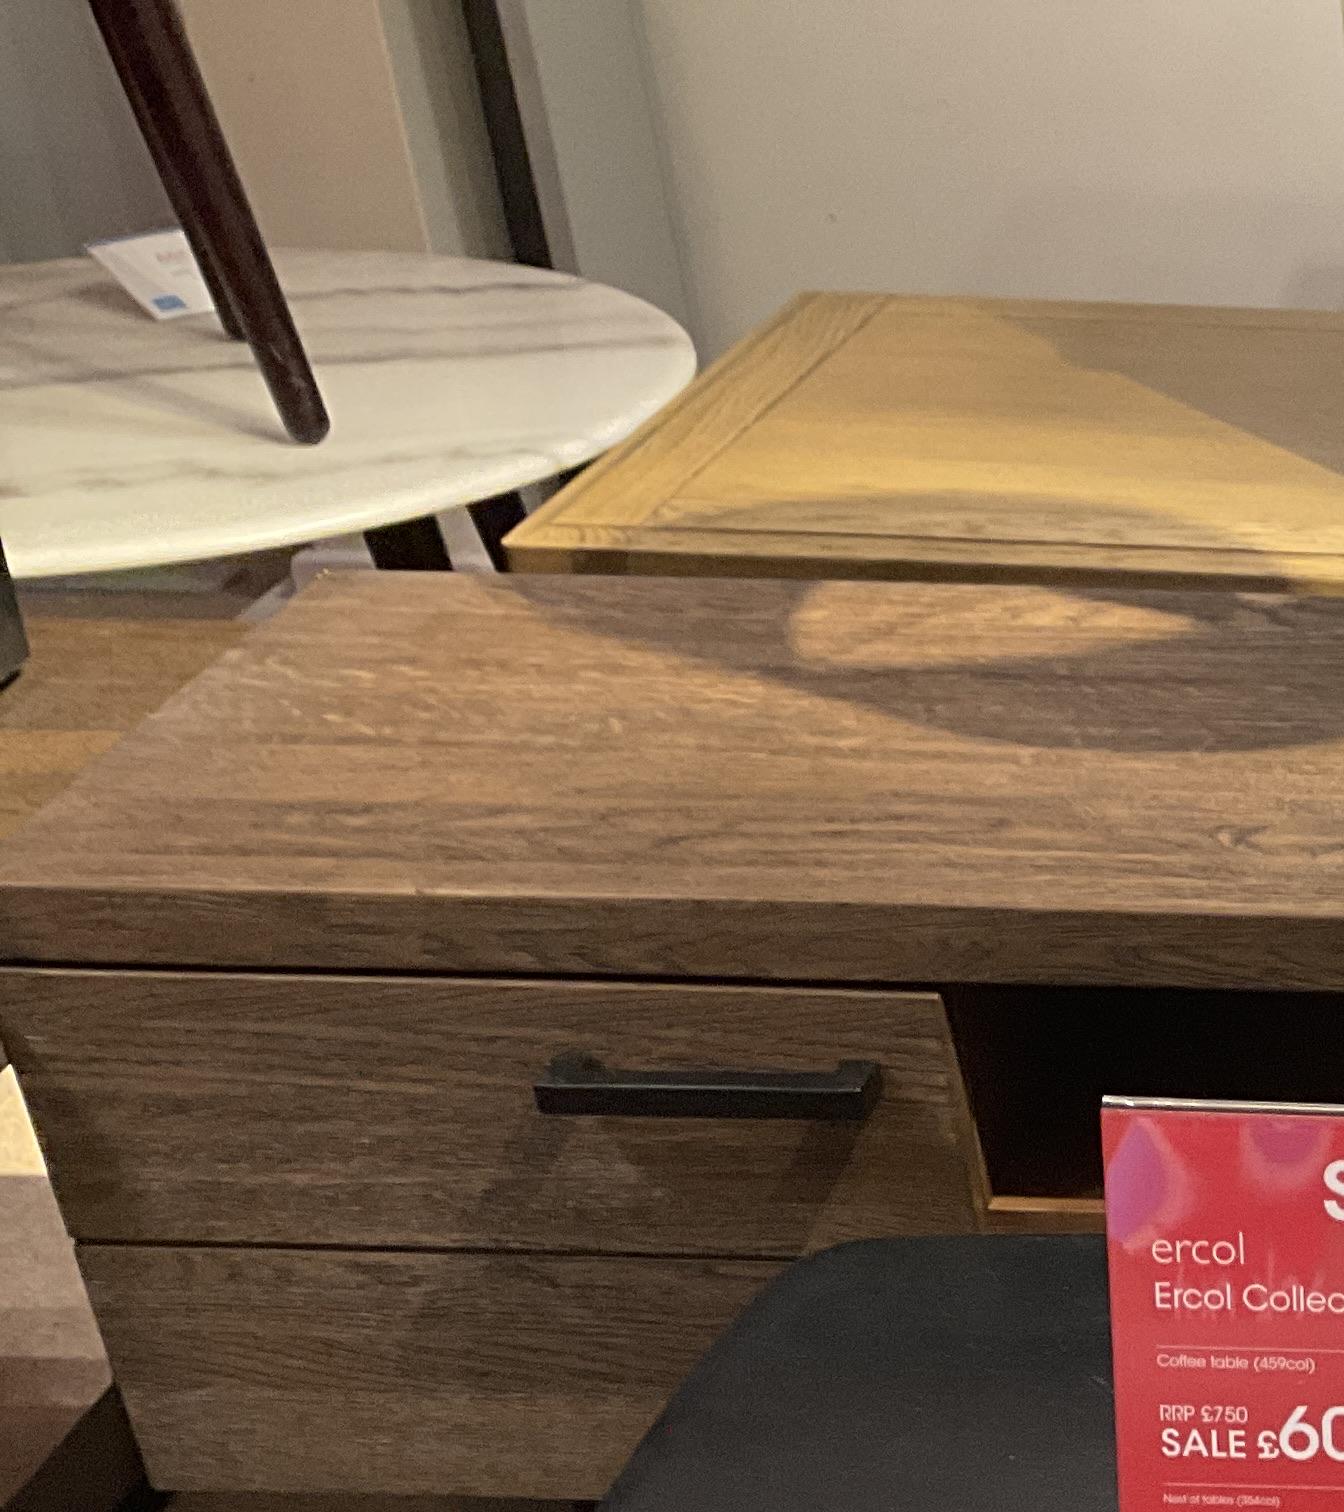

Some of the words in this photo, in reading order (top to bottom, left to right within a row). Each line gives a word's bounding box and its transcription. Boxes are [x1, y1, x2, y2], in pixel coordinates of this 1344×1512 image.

[1151, 1232, 1245, 1265] ercol
[1154, 1281, 1232, 1312] Ercol
[1157, 1354, 1206, 1368] Coffee
[1211, 1355, 1248, 1369] table
[1254, 1357, 1315, 1374] (459col)
[1159, 1404, 1195, 1421] RRP
[1201, 1405, 1248, 1423] £750
[1161, 1428, 1247, 1459] SALE
